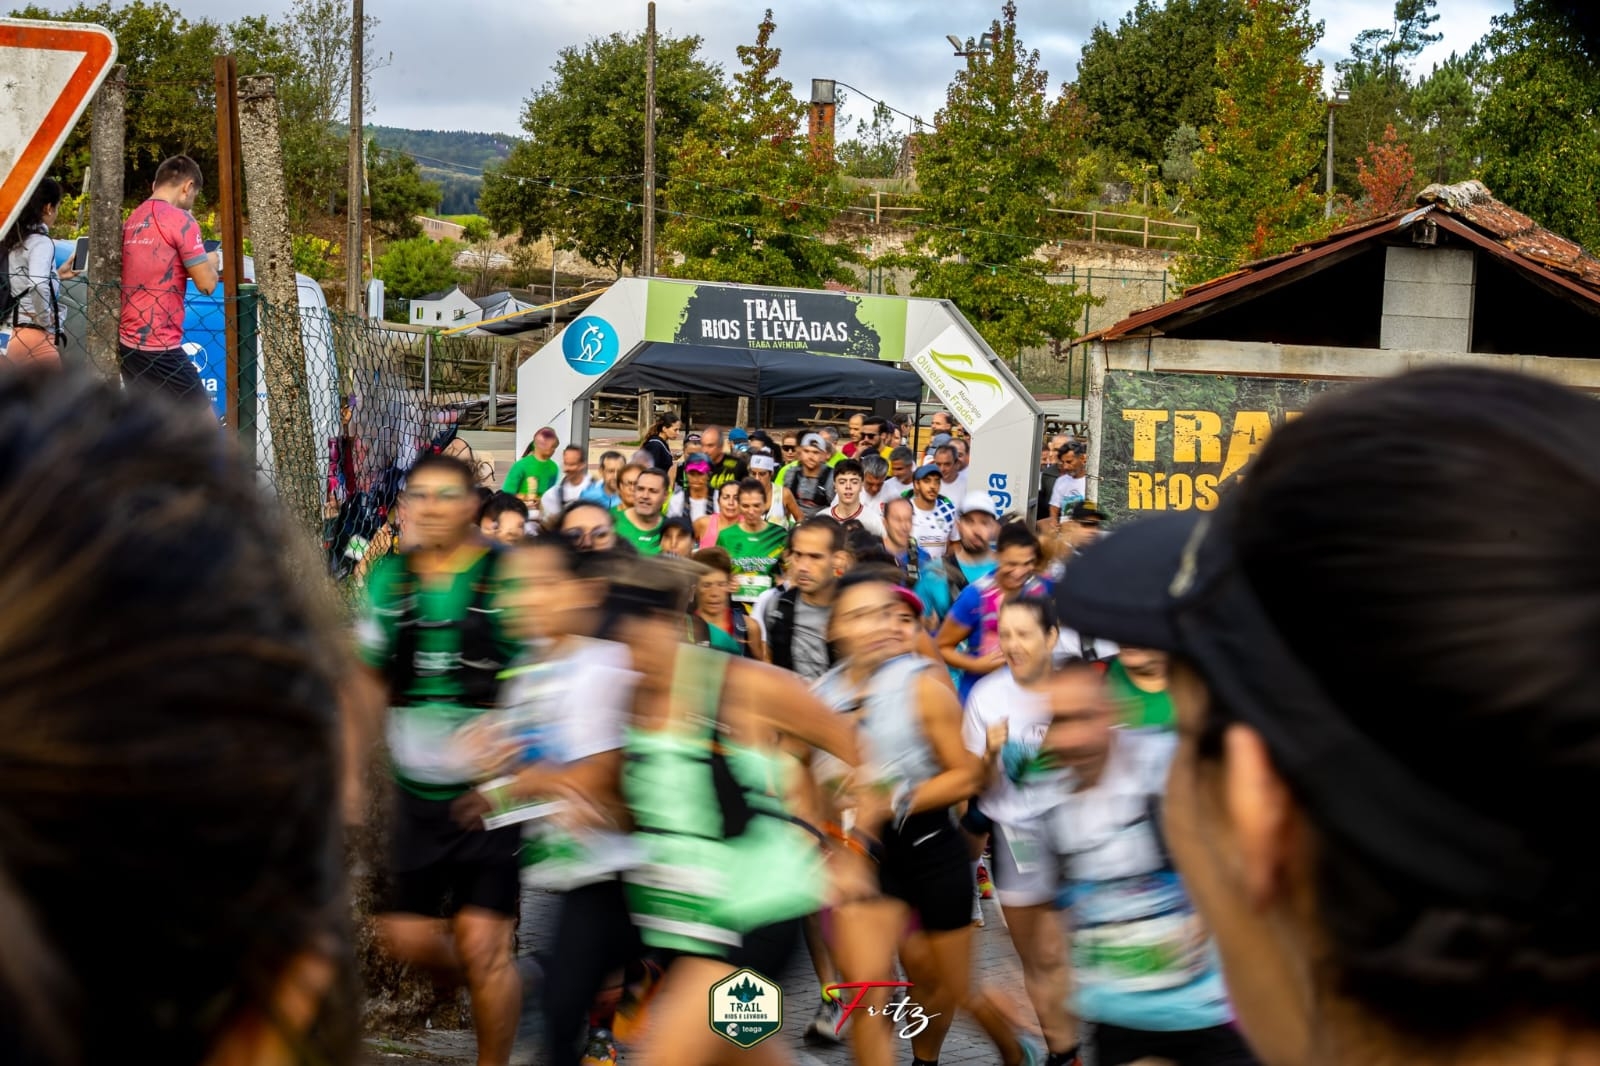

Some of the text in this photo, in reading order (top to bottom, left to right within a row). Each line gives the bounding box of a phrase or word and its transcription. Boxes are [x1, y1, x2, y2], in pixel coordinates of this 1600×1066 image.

[743, 299, 803, 321] TRAIL
[701, 319, 848, 342] RIOS E LEVADAS
[772, 341, 809, 350] AVENTURA
[917, 354, 975, 426] Oliveira de Frades
[1122, 409, 1302, 480] TRA
